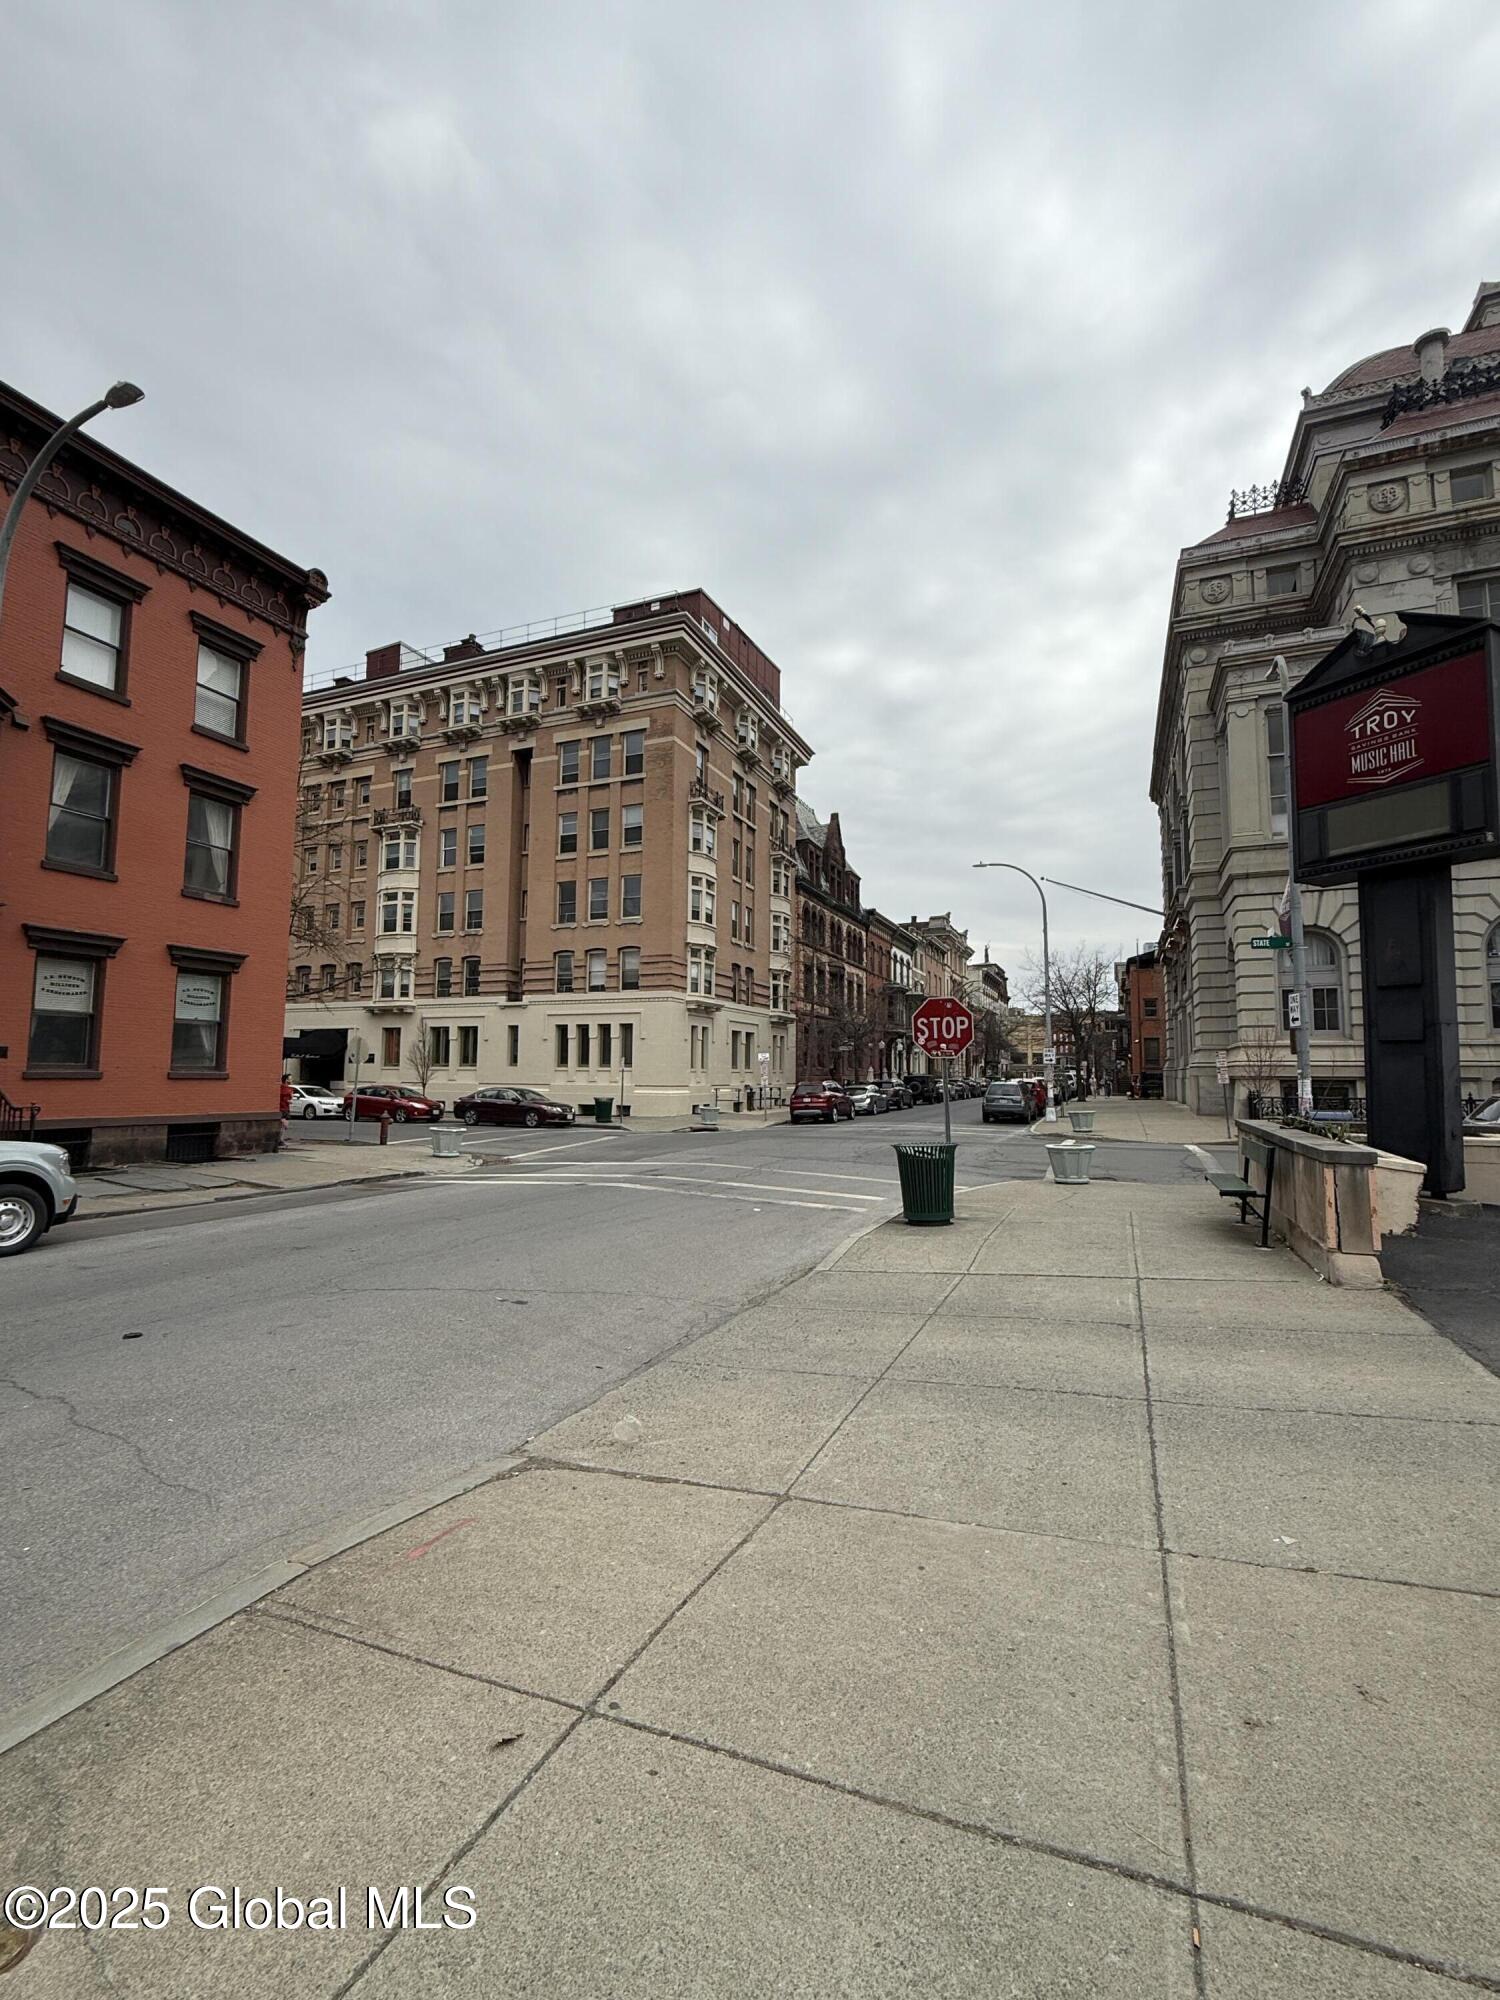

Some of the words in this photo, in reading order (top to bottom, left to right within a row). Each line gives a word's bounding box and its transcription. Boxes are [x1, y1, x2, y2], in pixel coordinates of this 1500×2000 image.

[1350, 709, 1416, 739] TROY
[1350, 735, 1390, 751] SAVINGS
[1391, 728, 1417, 738] BANK
[1351, 746, 1388, 775] MUSIC
[1389, 738, 1418, 764] HALL
[1252, 939, 1271, 947] STATE
[1289, 994, 1299, 1005] ONE
[1290, 1005, 1299, 1014] WAY
[916, 1016, 969, 1040] STOP
